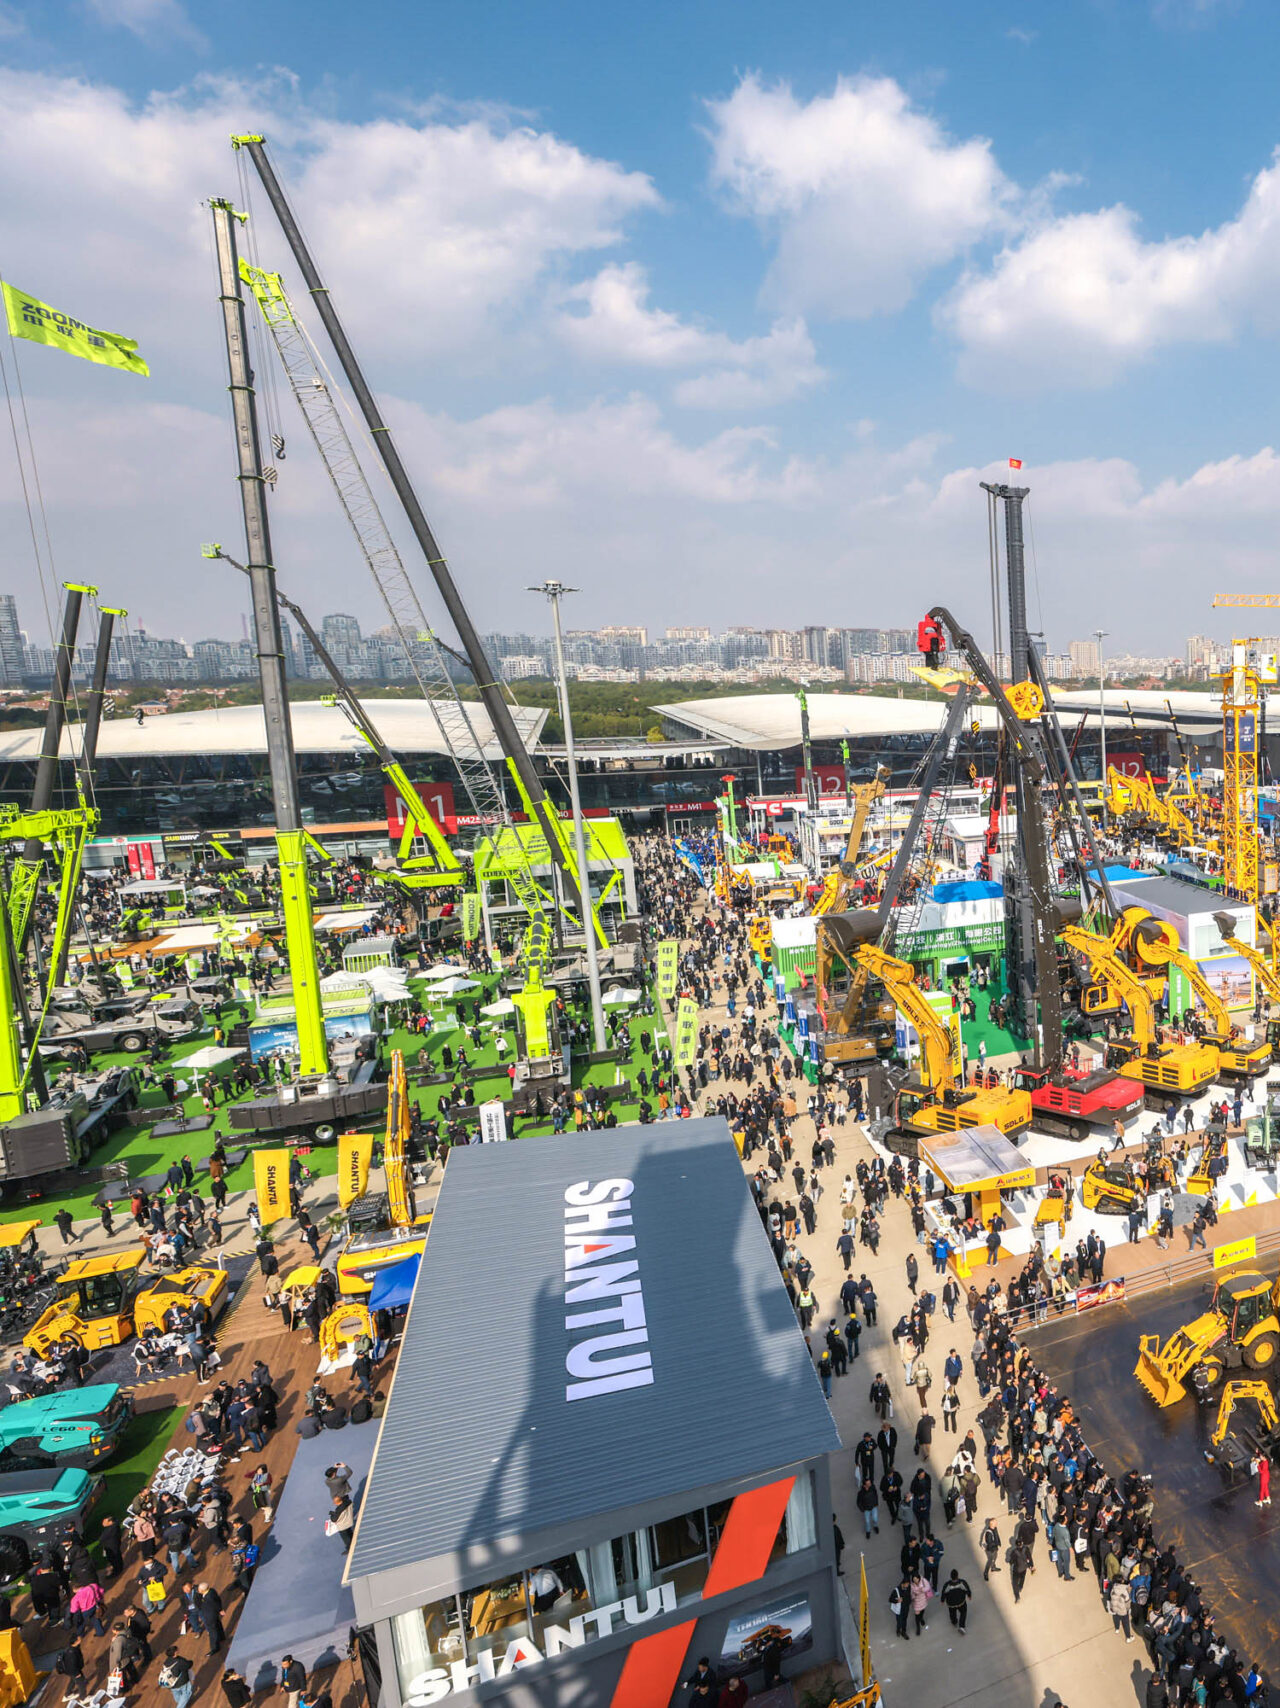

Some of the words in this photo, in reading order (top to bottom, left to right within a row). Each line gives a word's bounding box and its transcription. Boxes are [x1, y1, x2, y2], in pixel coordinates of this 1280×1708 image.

[20, 300, 99, 334] ZOOML
[687, 803, 702, 811] M41
[164, 834, 199, 842] SUBWAY
[267, 1165, 276, 1206] SHANTUI
[351, 1150, 360, 1194] SHANTUI
[564, 1178, 654, 1402] SHANTUI
[408, 1582, 677, 1708] SHANTUI
